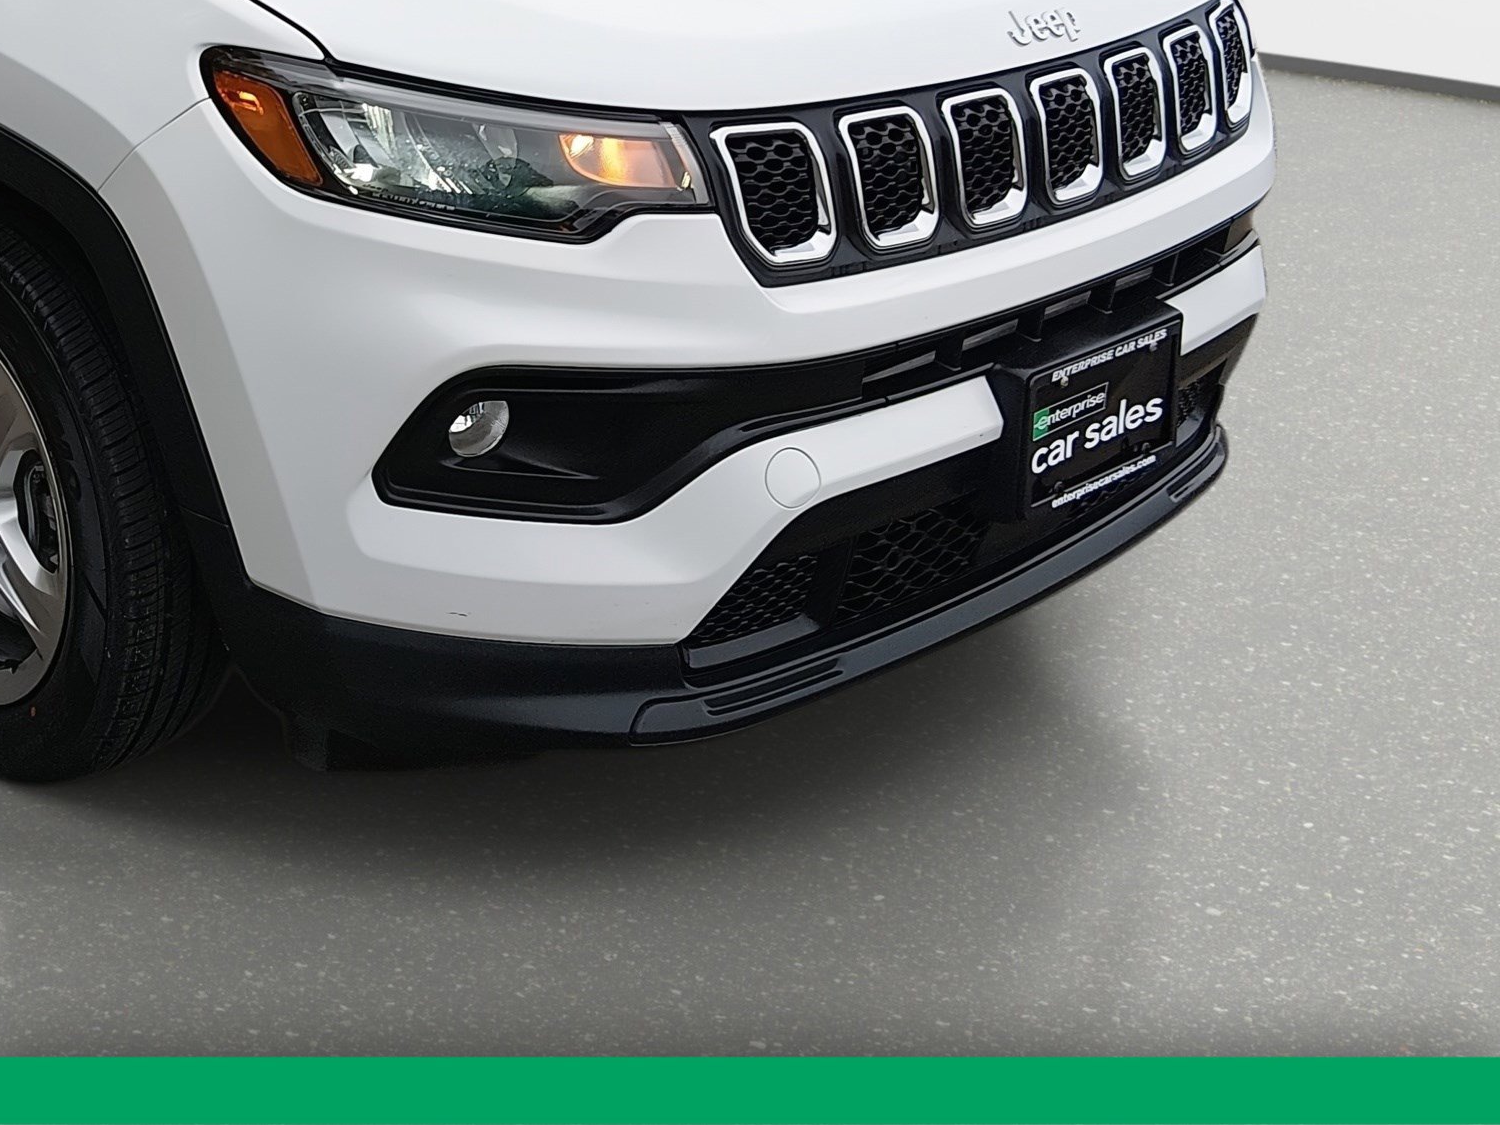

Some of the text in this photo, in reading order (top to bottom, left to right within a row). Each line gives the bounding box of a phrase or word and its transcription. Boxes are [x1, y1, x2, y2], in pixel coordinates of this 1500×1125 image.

[1006, 7, 1081, 46] Jeep
[1051, 328, 1168, 383] ENTERPRISE CAR SALES
[1035, 392, 1105, 430] enterprise
[1031, 397, 1163, 473] car sales
